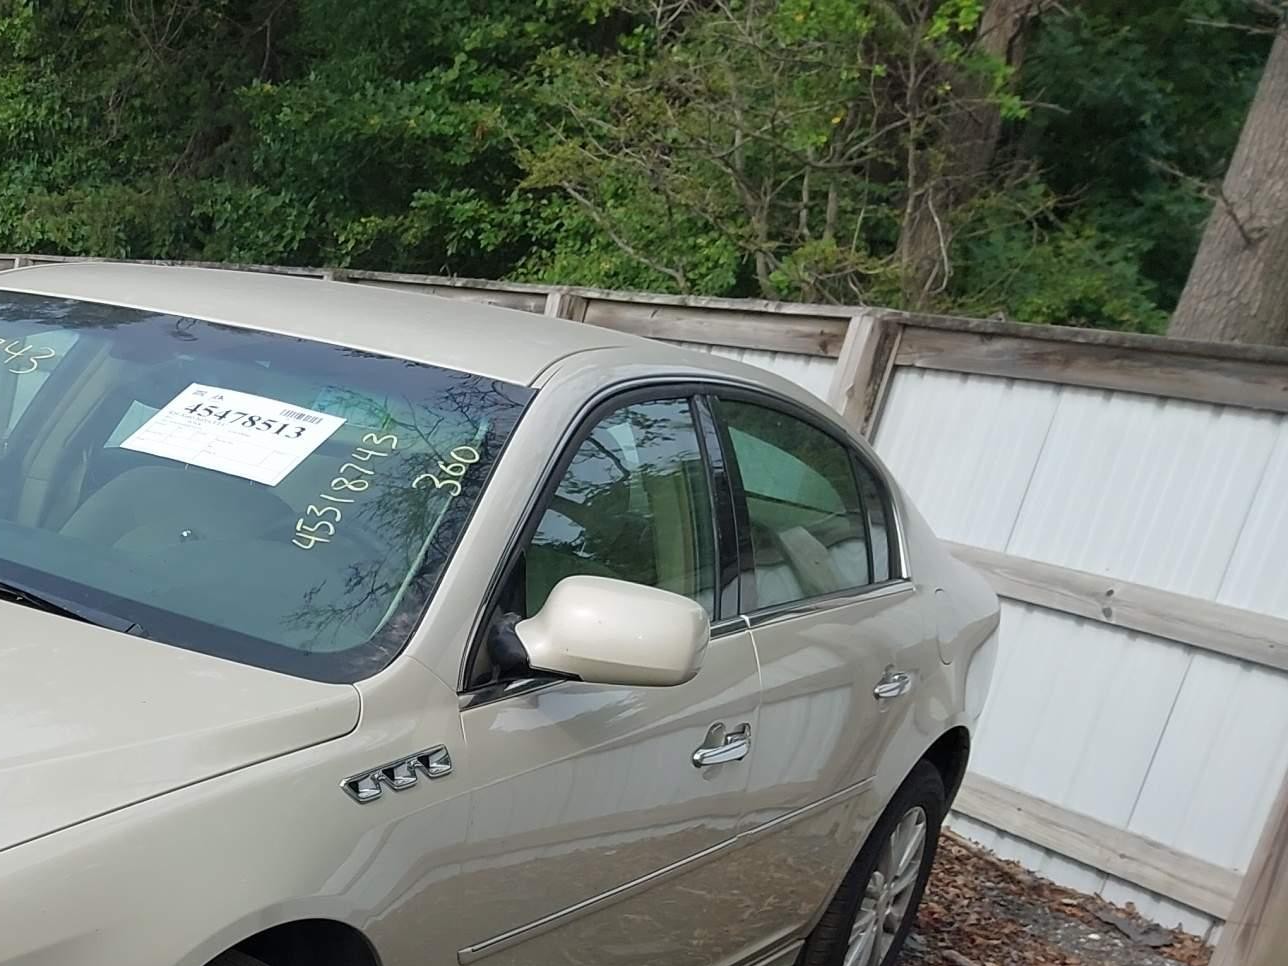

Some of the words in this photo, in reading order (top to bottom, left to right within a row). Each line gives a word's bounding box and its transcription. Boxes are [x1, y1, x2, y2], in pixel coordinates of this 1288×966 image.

[184, 402, 307, 440] 45478513
[291, 432, 398, 549] 45318743
[411, 445, 481, 497] 360
